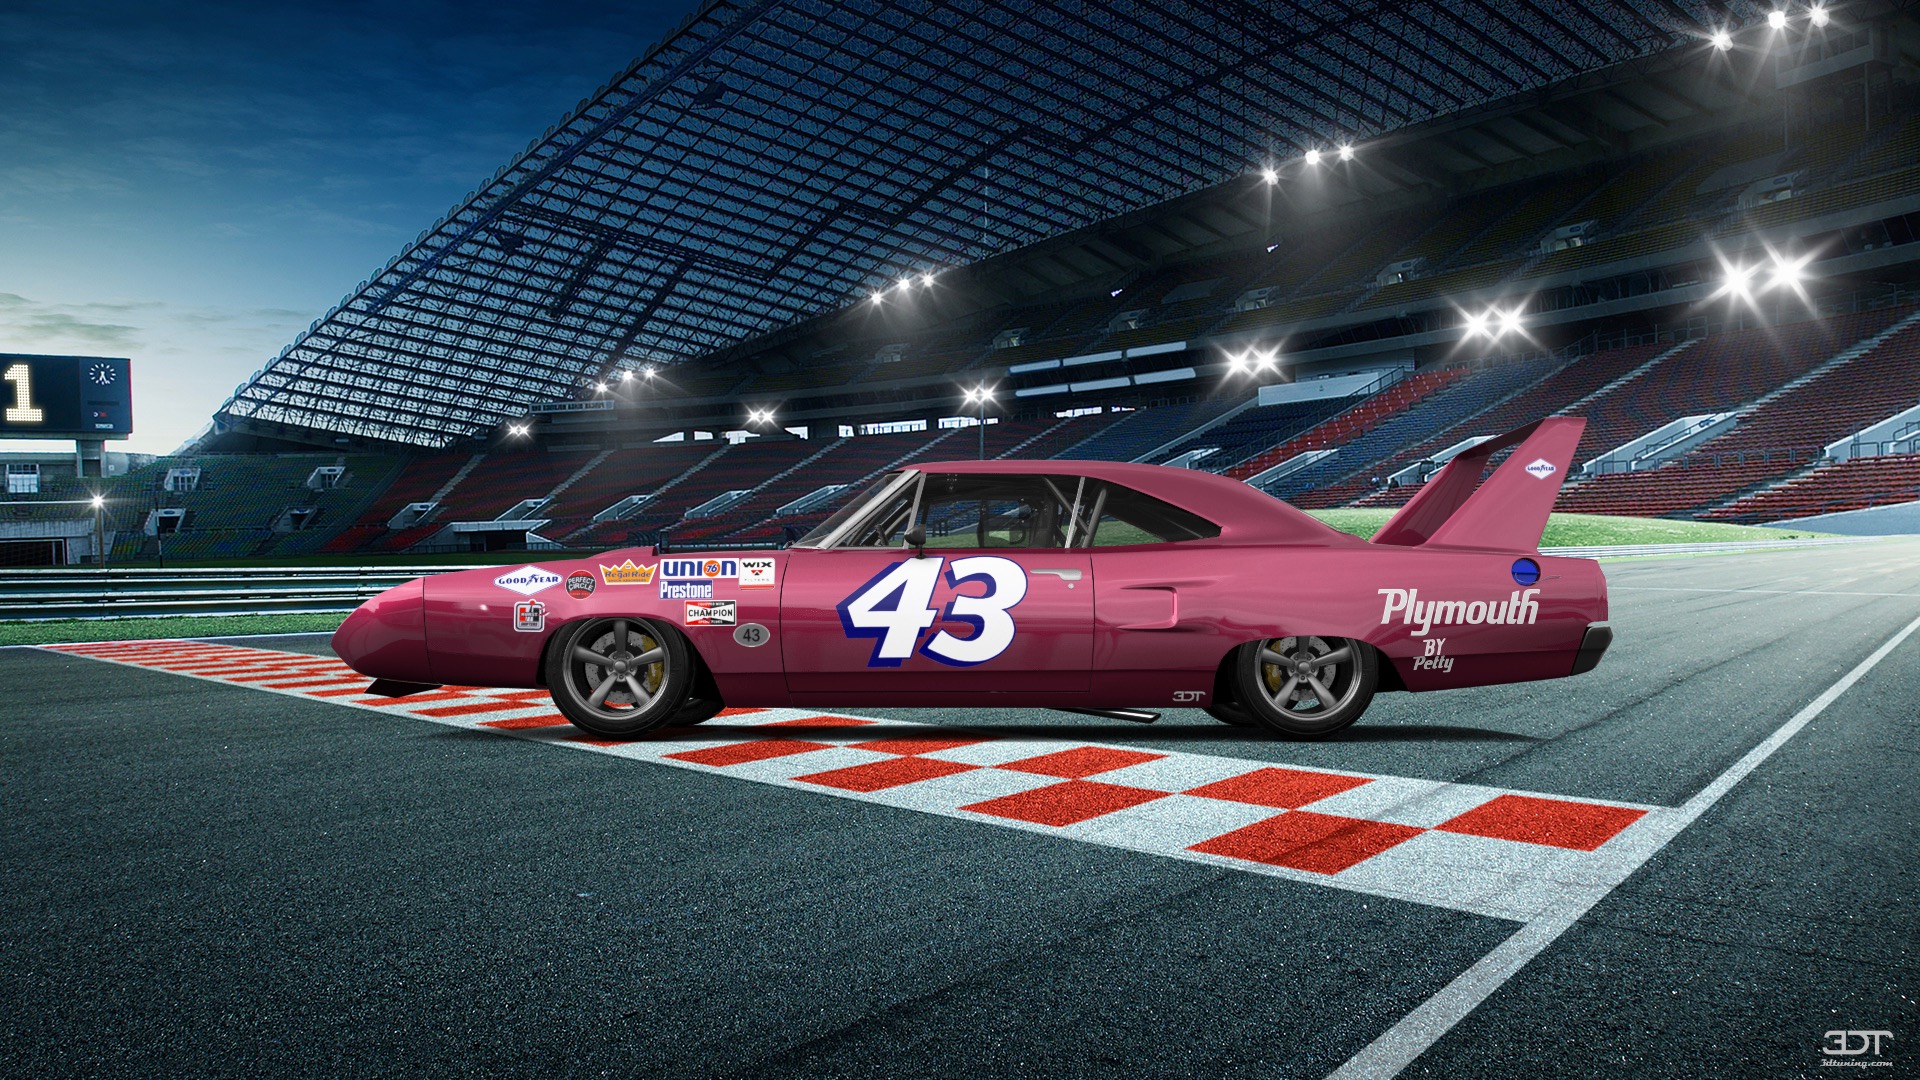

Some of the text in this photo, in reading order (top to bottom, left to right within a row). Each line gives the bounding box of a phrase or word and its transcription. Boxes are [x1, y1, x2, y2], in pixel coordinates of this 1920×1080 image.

[4, 364, 43, 422] 1
[706, 564, 718, 573] 76
[567, 576, 595, 584] PERFECT
[568, 582, 594, 591] CIRCLE
[660, 581, 712, 599] Prestone
[688, 609, 733, 617] CHAMPION
[836, 555, 1029, 668] 43
[1377, 588, 1540, 636] Plymouth
[743, 628, 761, 642] 43
[1423, 638, 1446, 657] BY
[1413, 656, 1454, 673] Petty
